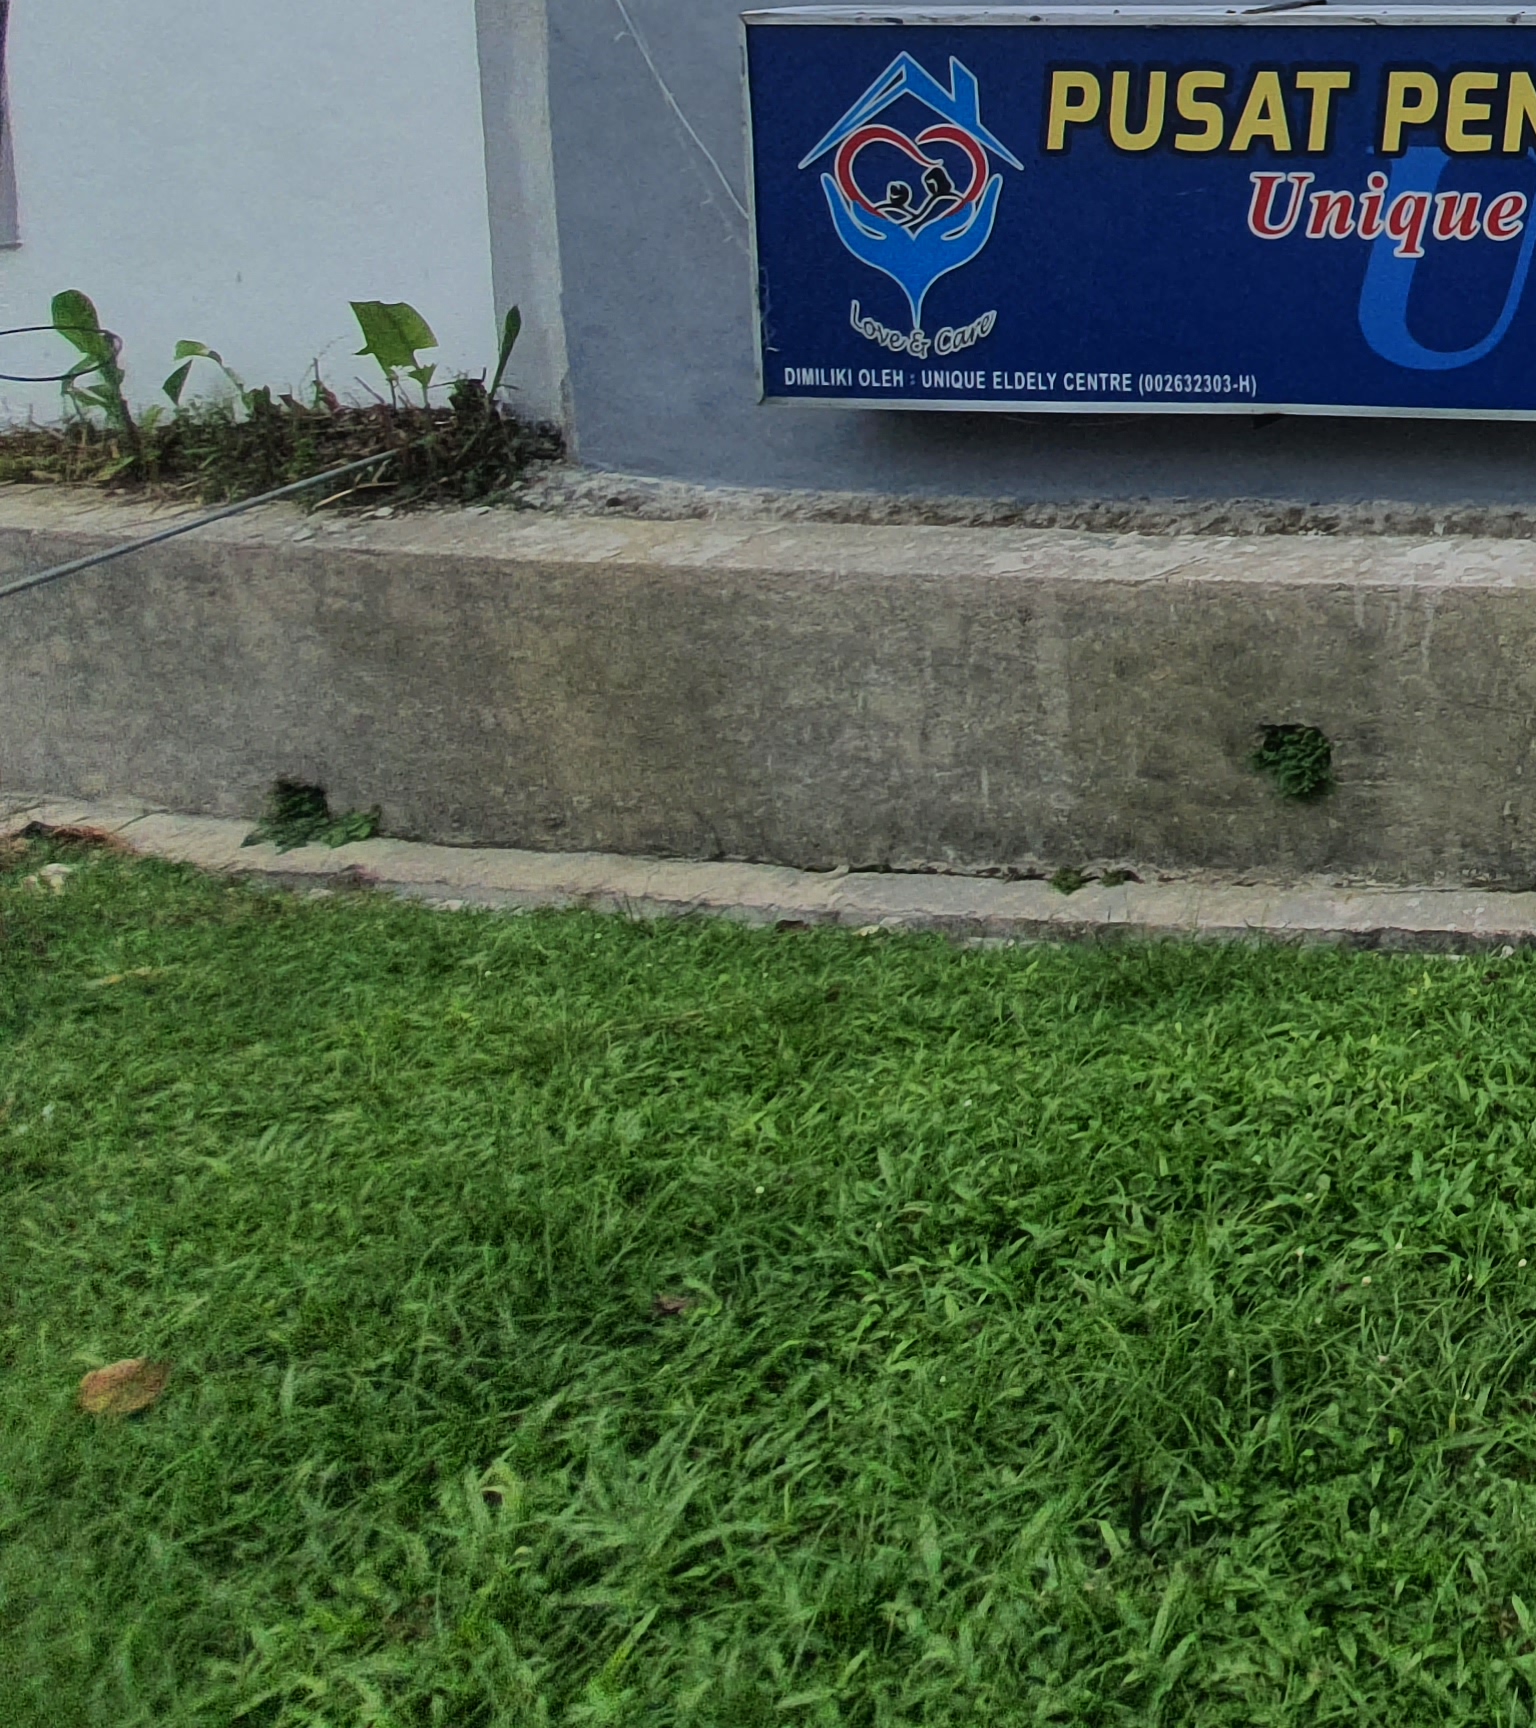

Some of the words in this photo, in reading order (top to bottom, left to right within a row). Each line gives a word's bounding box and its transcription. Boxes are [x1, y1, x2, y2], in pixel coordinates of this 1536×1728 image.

[1045, 70, 1351, 153] PUSAT
[1249, 172, 1525, 258] Unique
[850, 299, 908, 352] Love
[934, 310, 997, 355] Care
[784, 367, 852, 386] DIMILIKI
[858, 369, 904, 387] OLEH
[922, 370, 986, 390] UNIQUE
[993, 371, 1057, 391] ELDELY
[1063, 372, 1132, 392] CENTRE
[1138, 373, 1257, 397] (002632303-H)
